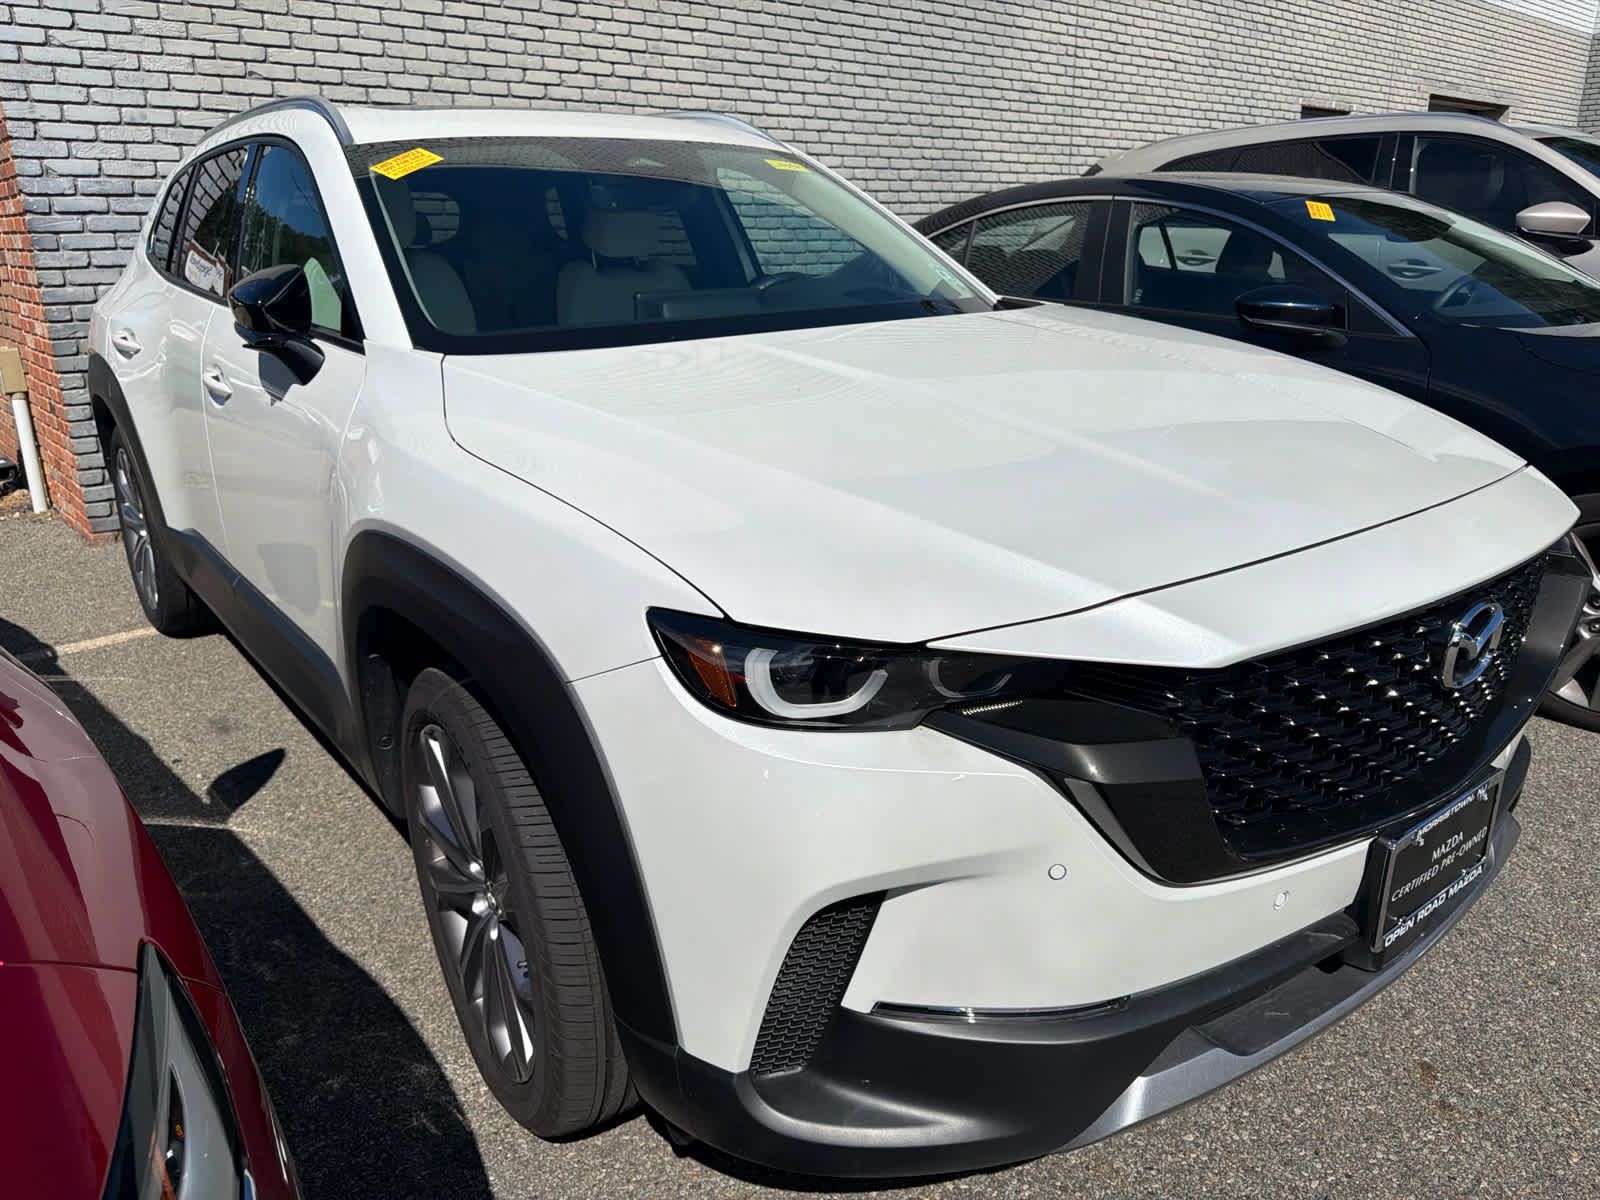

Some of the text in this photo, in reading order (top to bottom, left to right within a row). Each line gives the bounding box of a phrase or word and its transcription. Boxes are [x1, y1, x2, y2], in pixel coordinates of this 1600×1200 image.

[1392, 826, 1488, 902] CERTIFIED PRE-OWNED
[1432, 831, 1463, 862] MAZDA
[1385, 865, 1482, 947] OPEN ROAD MAZDA
